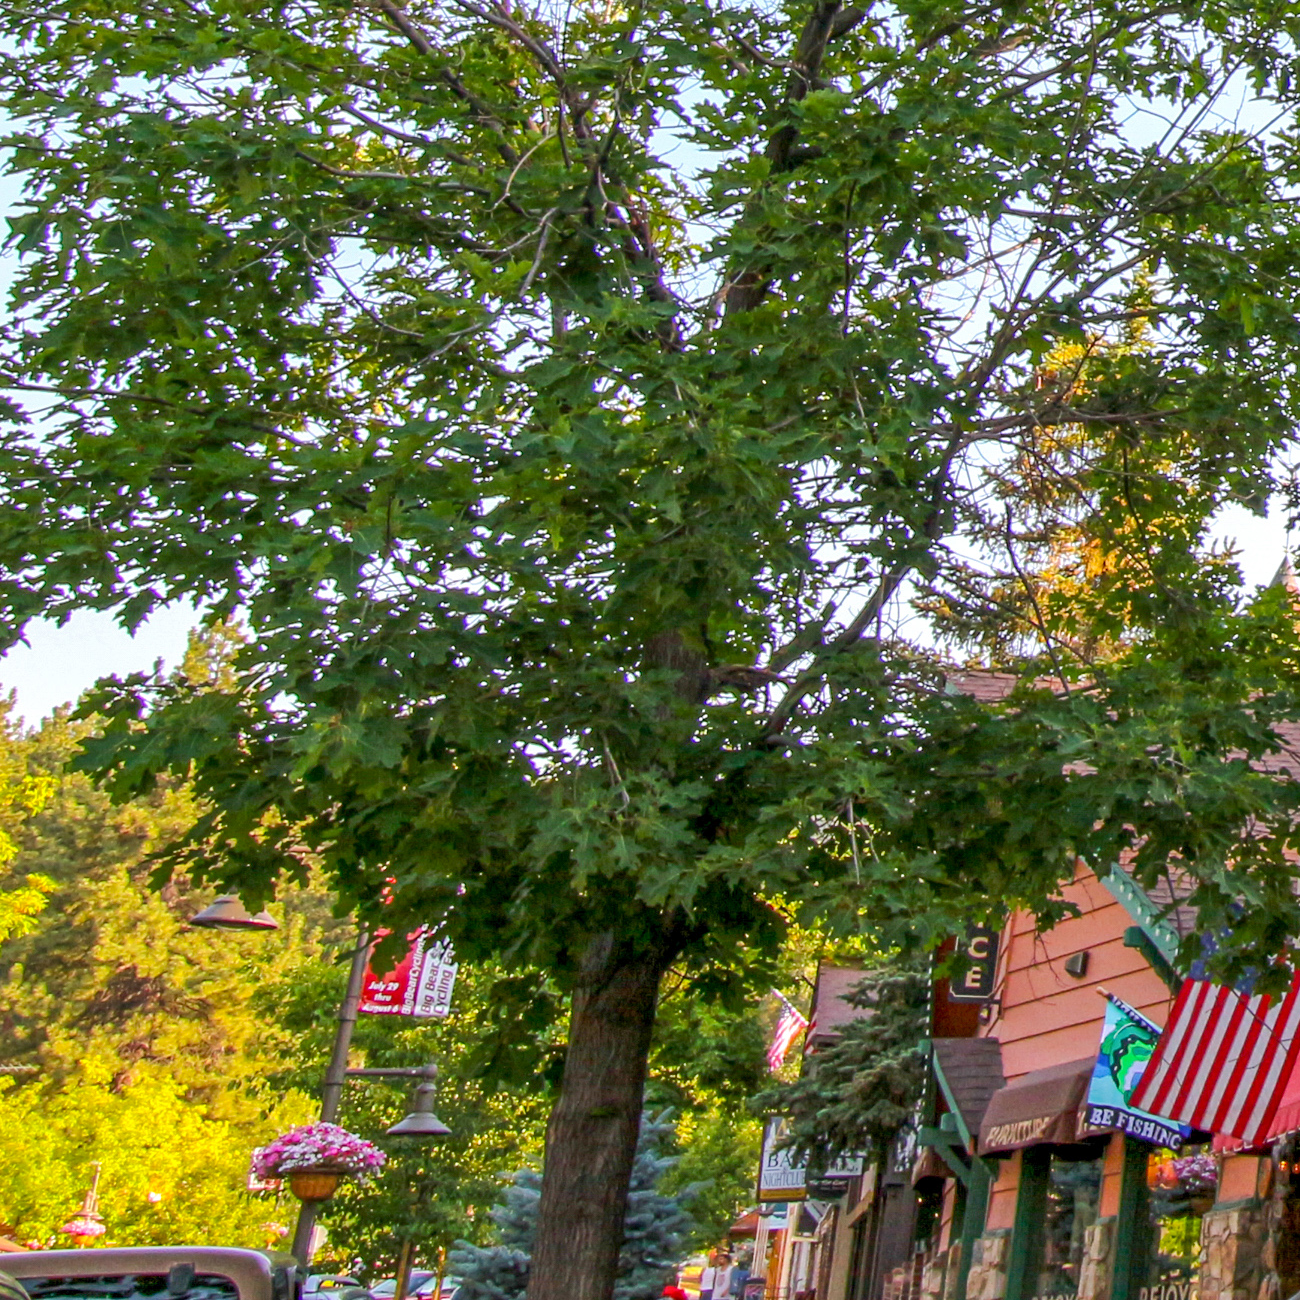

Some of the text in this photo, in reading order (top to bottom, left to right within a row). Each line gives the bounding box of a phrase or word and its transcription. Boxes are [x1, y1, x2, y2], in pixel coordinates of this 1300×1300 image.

[368, 980, 400, 992] July 29
[374, 992, 392, 1002] thru
[420, 962, 440, 1014] Big Bear
[433, 968, 454, 1015] Cycling
[362, 1003, 400, 1014] August 6
[1089, 1107, 1112, 1127] BE
[1115, 1111, 1184, 1150] FISHING
